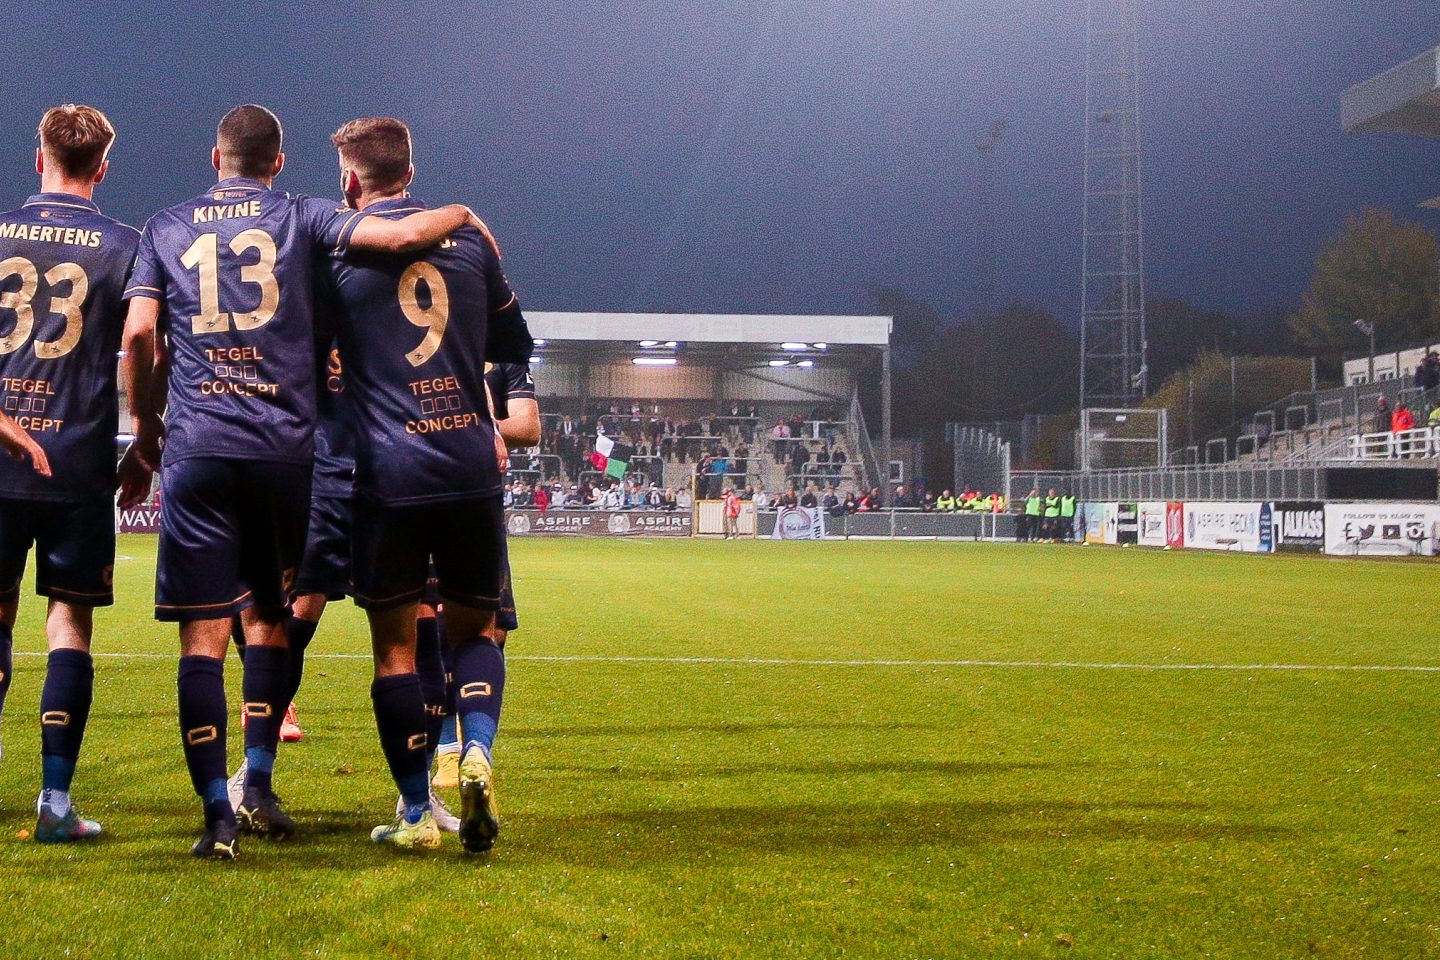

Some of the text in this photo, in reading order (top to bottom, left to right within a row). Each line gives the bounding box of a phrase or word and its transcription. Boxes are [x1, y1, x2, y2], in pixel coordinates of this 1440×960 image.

[193, 201, 262, 224] KIYINE
[179, 228, 280, 335] 13
[398, 261, 449, 368] 9
[205, 347, 263, 363] TEGEL
[2, 378, 55, 395] TEGEL
[409, 376, 461, 396] TEGEL
[15, 416, 63, 433] CEPT
[405, 413, 480, 435] CONCEPT
[536, 516, 591, 526] ASPIRE
[636, 516, 691, 526] ASPIRE
